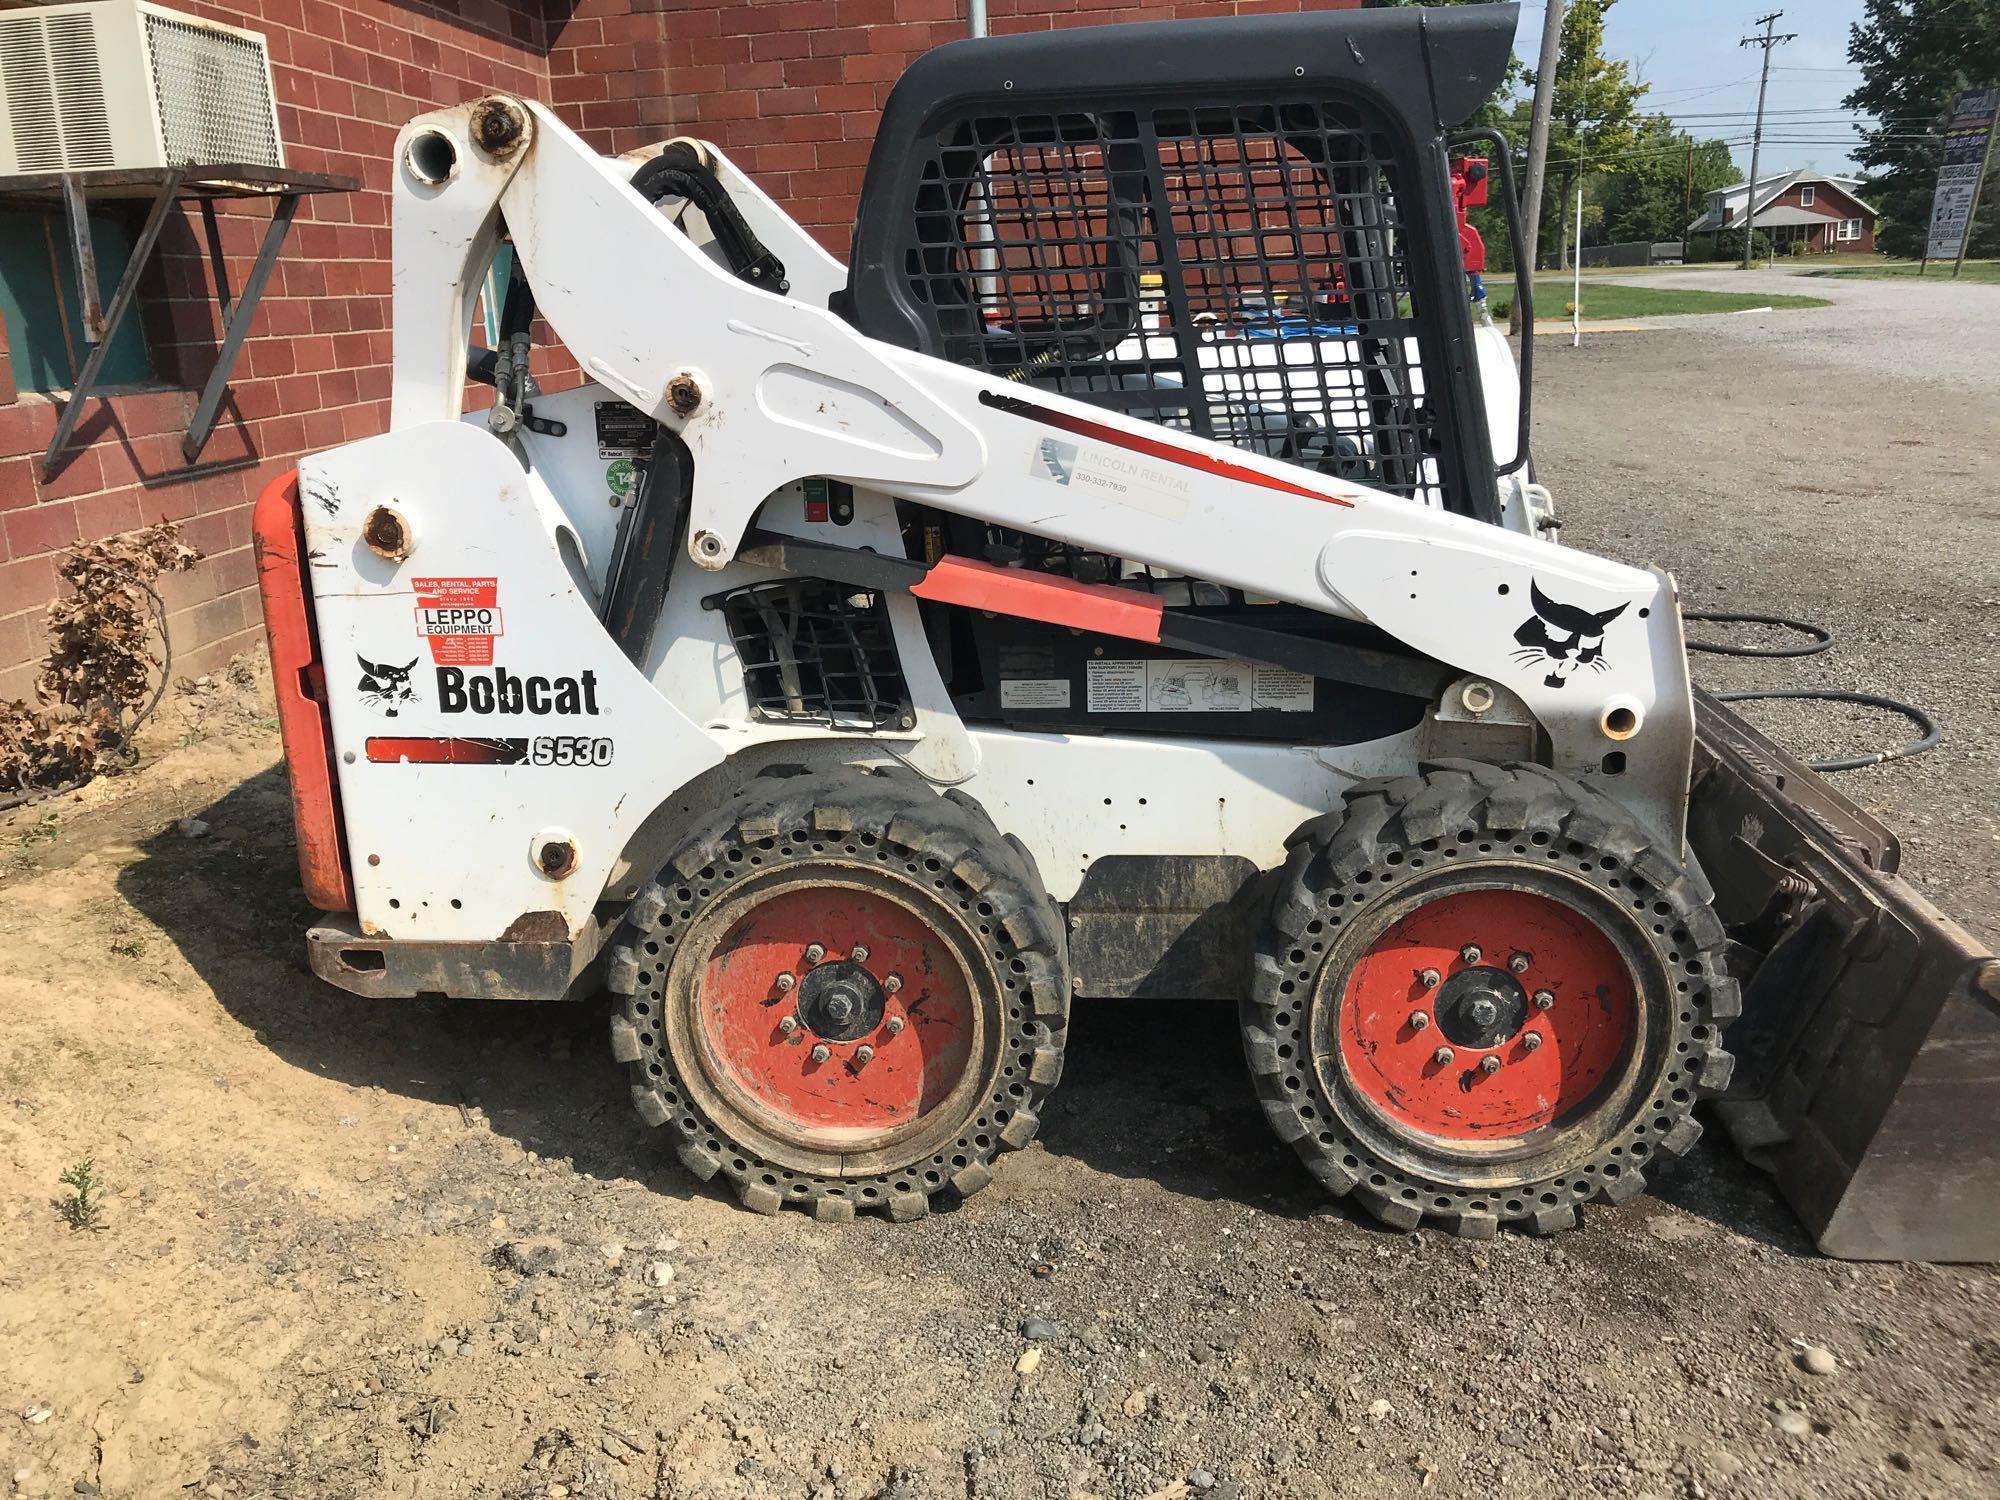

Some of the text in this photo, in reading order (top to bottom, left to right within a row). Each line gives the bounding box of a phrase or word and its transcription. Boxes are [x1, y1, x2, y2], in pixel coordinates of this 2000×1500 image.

[1075, 472, 1127, 493] 330-332-7930
[1082, 451, 1193, 493] LINCOLN RENTAL
[414, 581, 440, 589] SALES,
[424, 609, 492, 625] LEPPO
[427, 625, 493, 634] EQUIPMENT
[436, 666, 600, 716] Bobcat
[533, 736, 614, 767] S530
